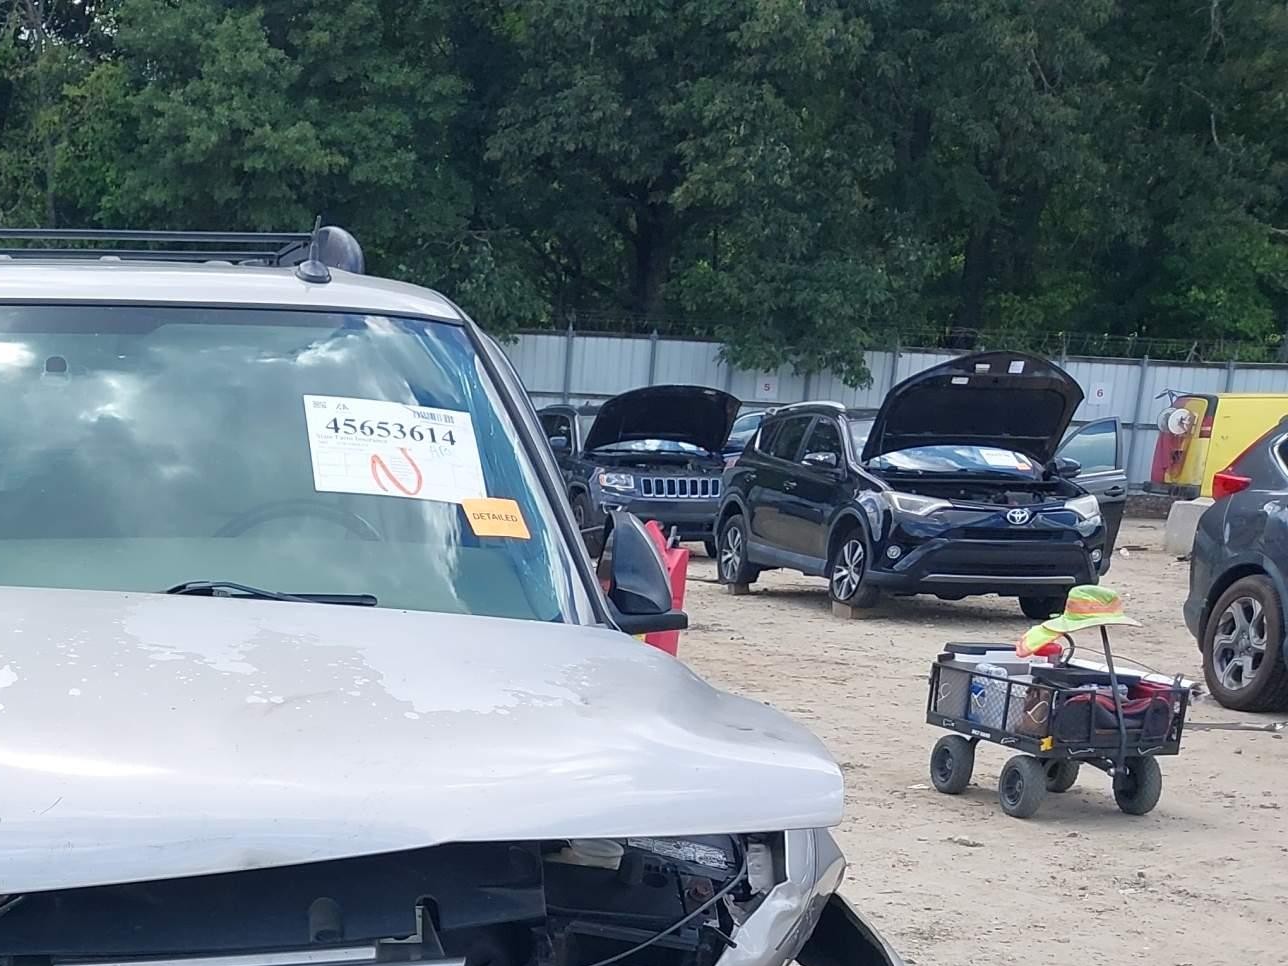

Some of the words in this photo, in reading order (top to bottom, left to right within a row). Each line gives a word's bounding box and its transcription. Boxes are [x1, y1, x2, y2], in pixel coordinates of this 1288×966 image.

[1096, 389, 1104, 398] 6
[325, 416, 457, 446] 45653614
[472, 512, 518, 522] DETAILED
